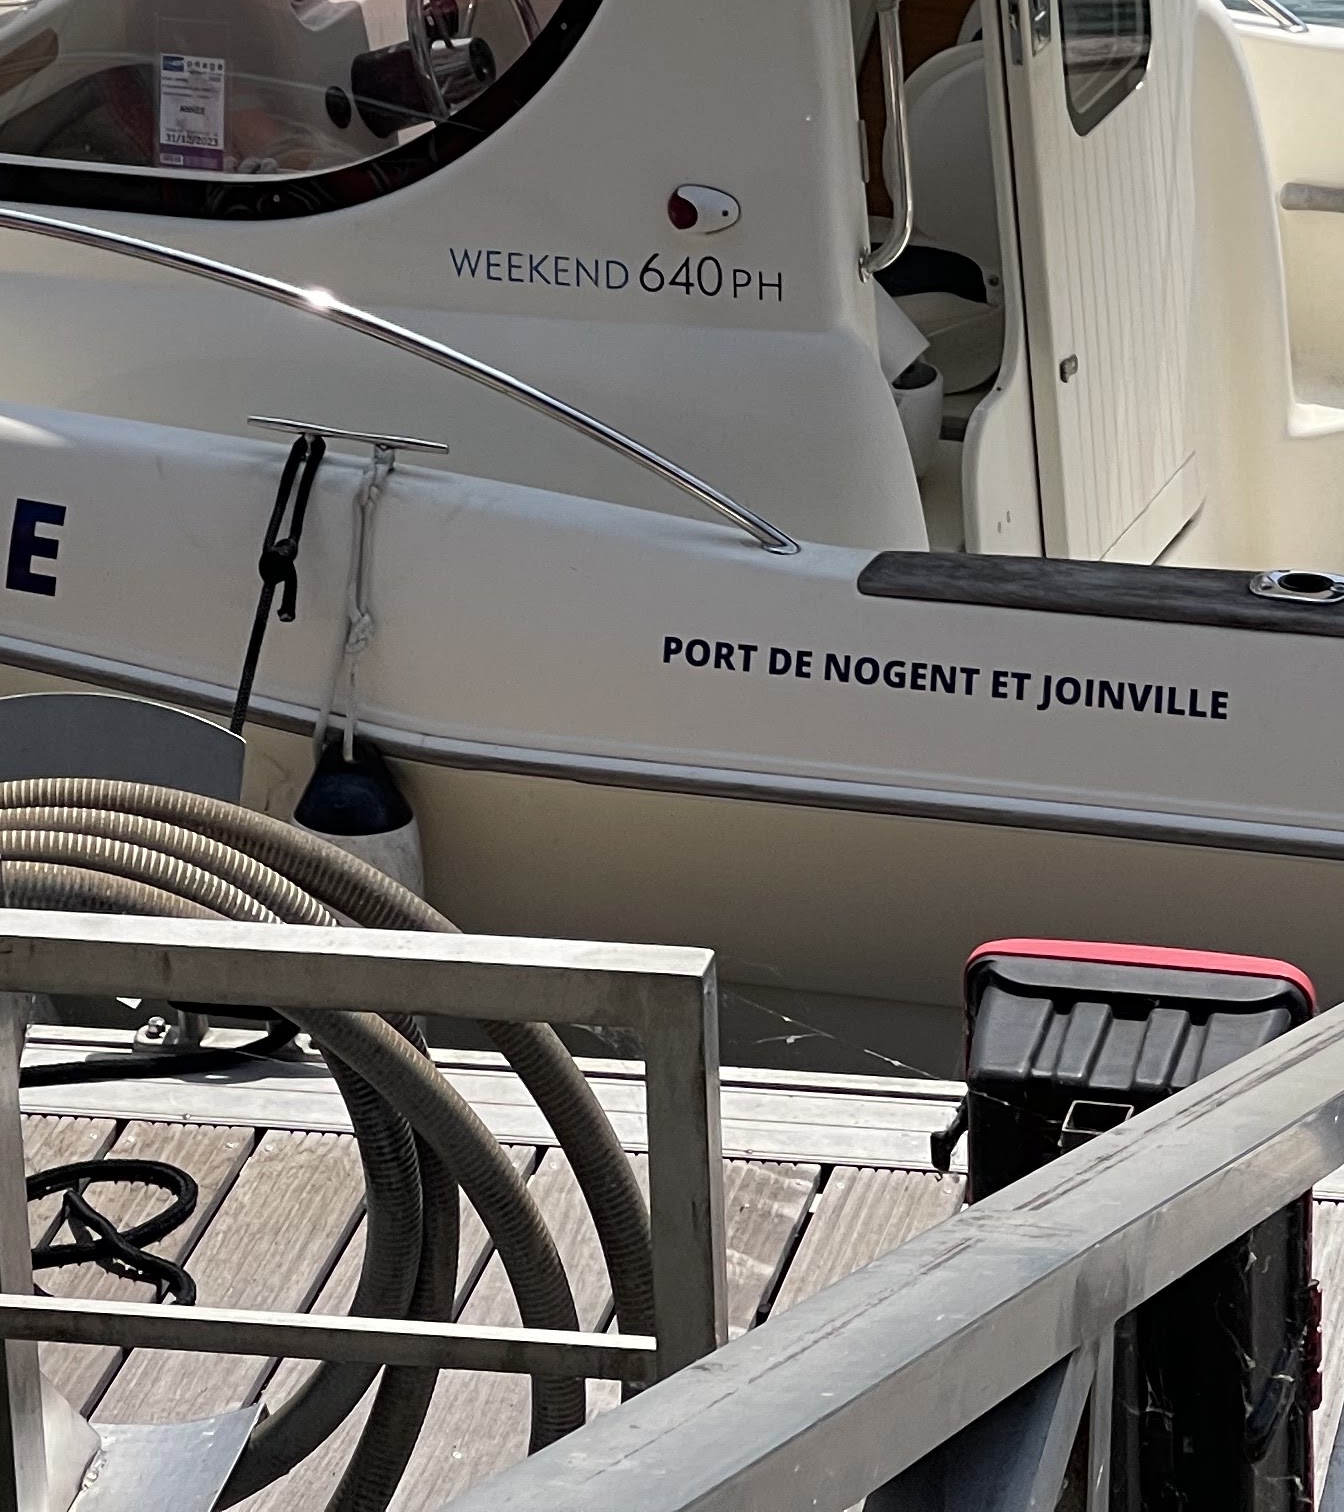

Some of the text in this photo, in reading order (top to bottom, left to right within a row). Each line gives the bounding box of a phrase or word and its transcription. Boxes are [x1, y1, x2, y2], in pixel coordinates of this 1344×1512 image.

[449, 247, 783, 303] WEEKEND 640 PH
[662, 636, 1230, 721] PORT DE NOGENT ET JOINVILLE
